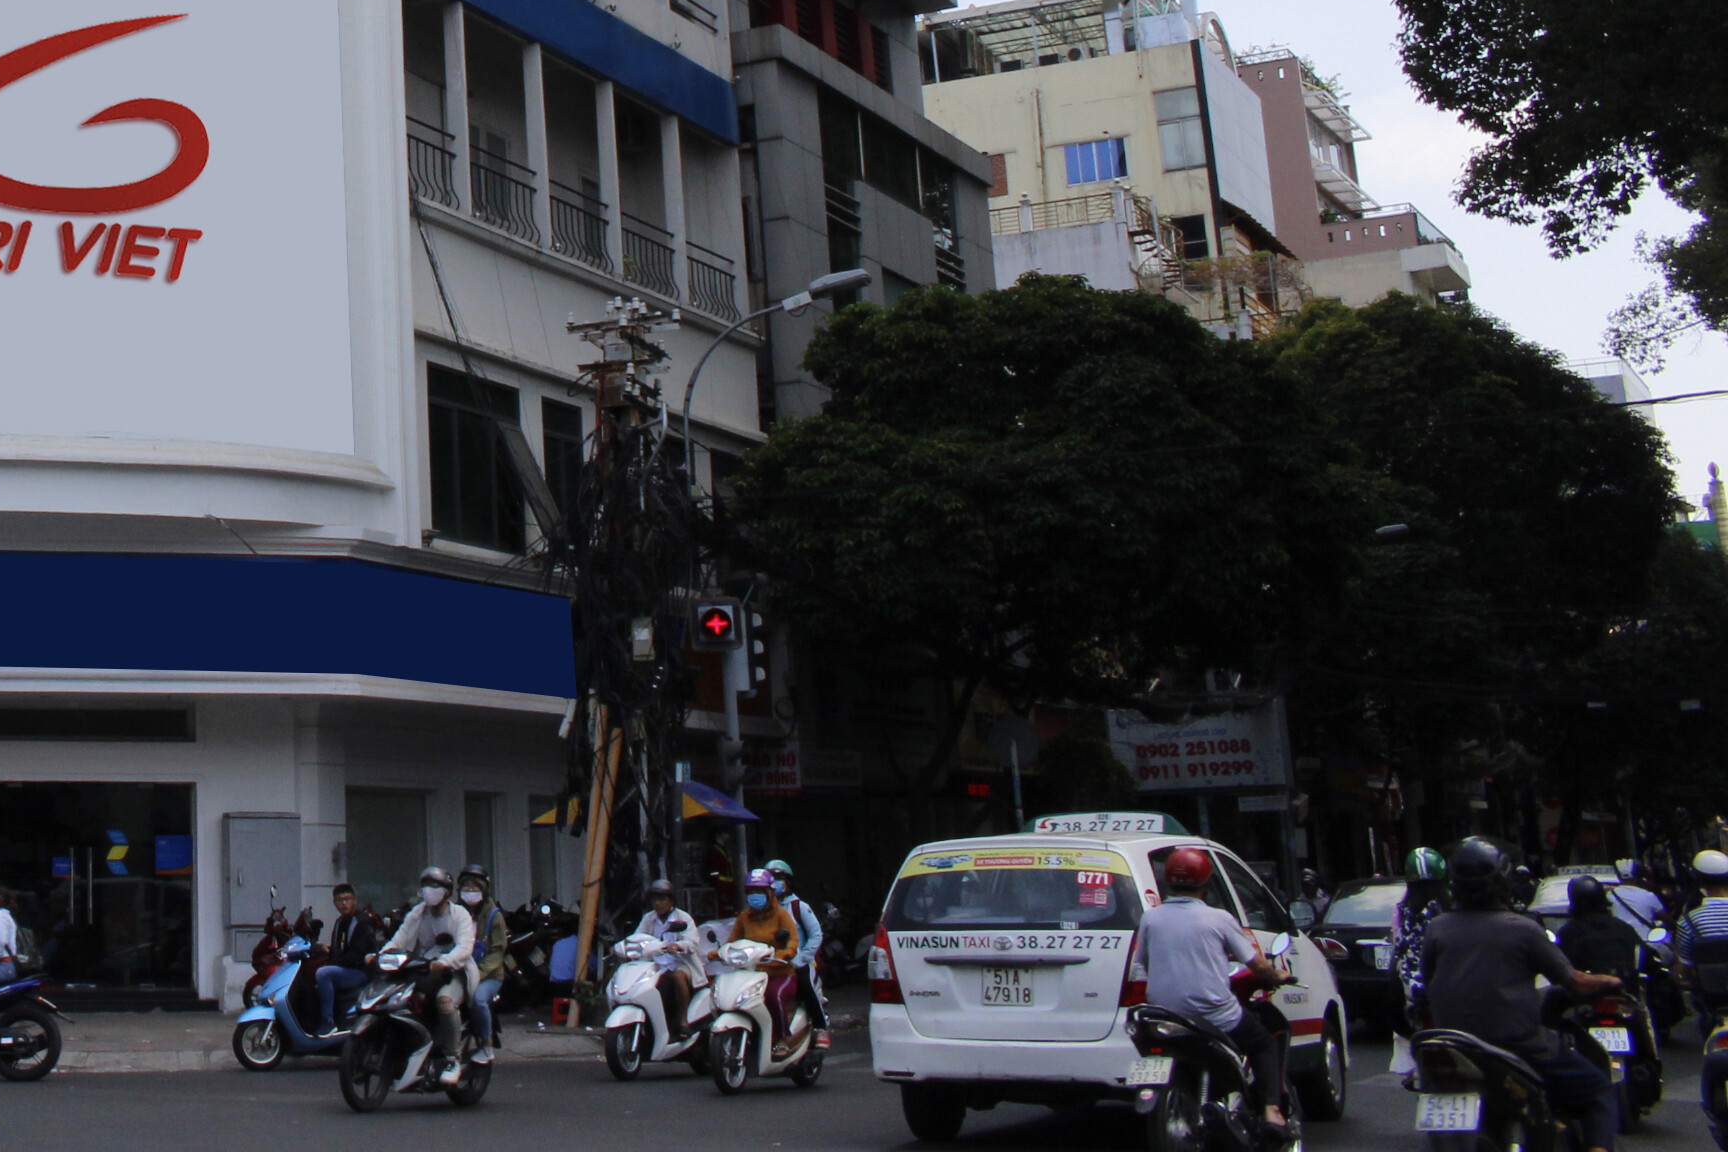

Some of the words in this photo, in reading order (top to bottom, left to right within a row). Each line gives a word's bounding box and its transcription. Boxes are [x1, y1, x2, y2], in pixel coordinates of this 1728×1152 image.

[59, 221, 203, 282] VIET
[1136, 742, 1180, 759] 0902
[1185, 739, 1252, 756] 251088
[1138, 764, 1180, 780] 0911
[1187, 760, 1254, 777] 919299
[1112, 820, 1130, 831] 27
[1135, 819, 1155, 830] 27
[1037, 855, 1075, 866] 15.5%
[1077, 871, 1109, 884] 6771
[897, 936, 959, 949] VINASUN
[962, 936, 990, 948] TAXI
[1017, 935, 1067, 949] 38.27
[1073, 935, 1094, 949] 27
[1101, 935, 1122, 949] 27
[993, 969, 1020, 985] 51A
